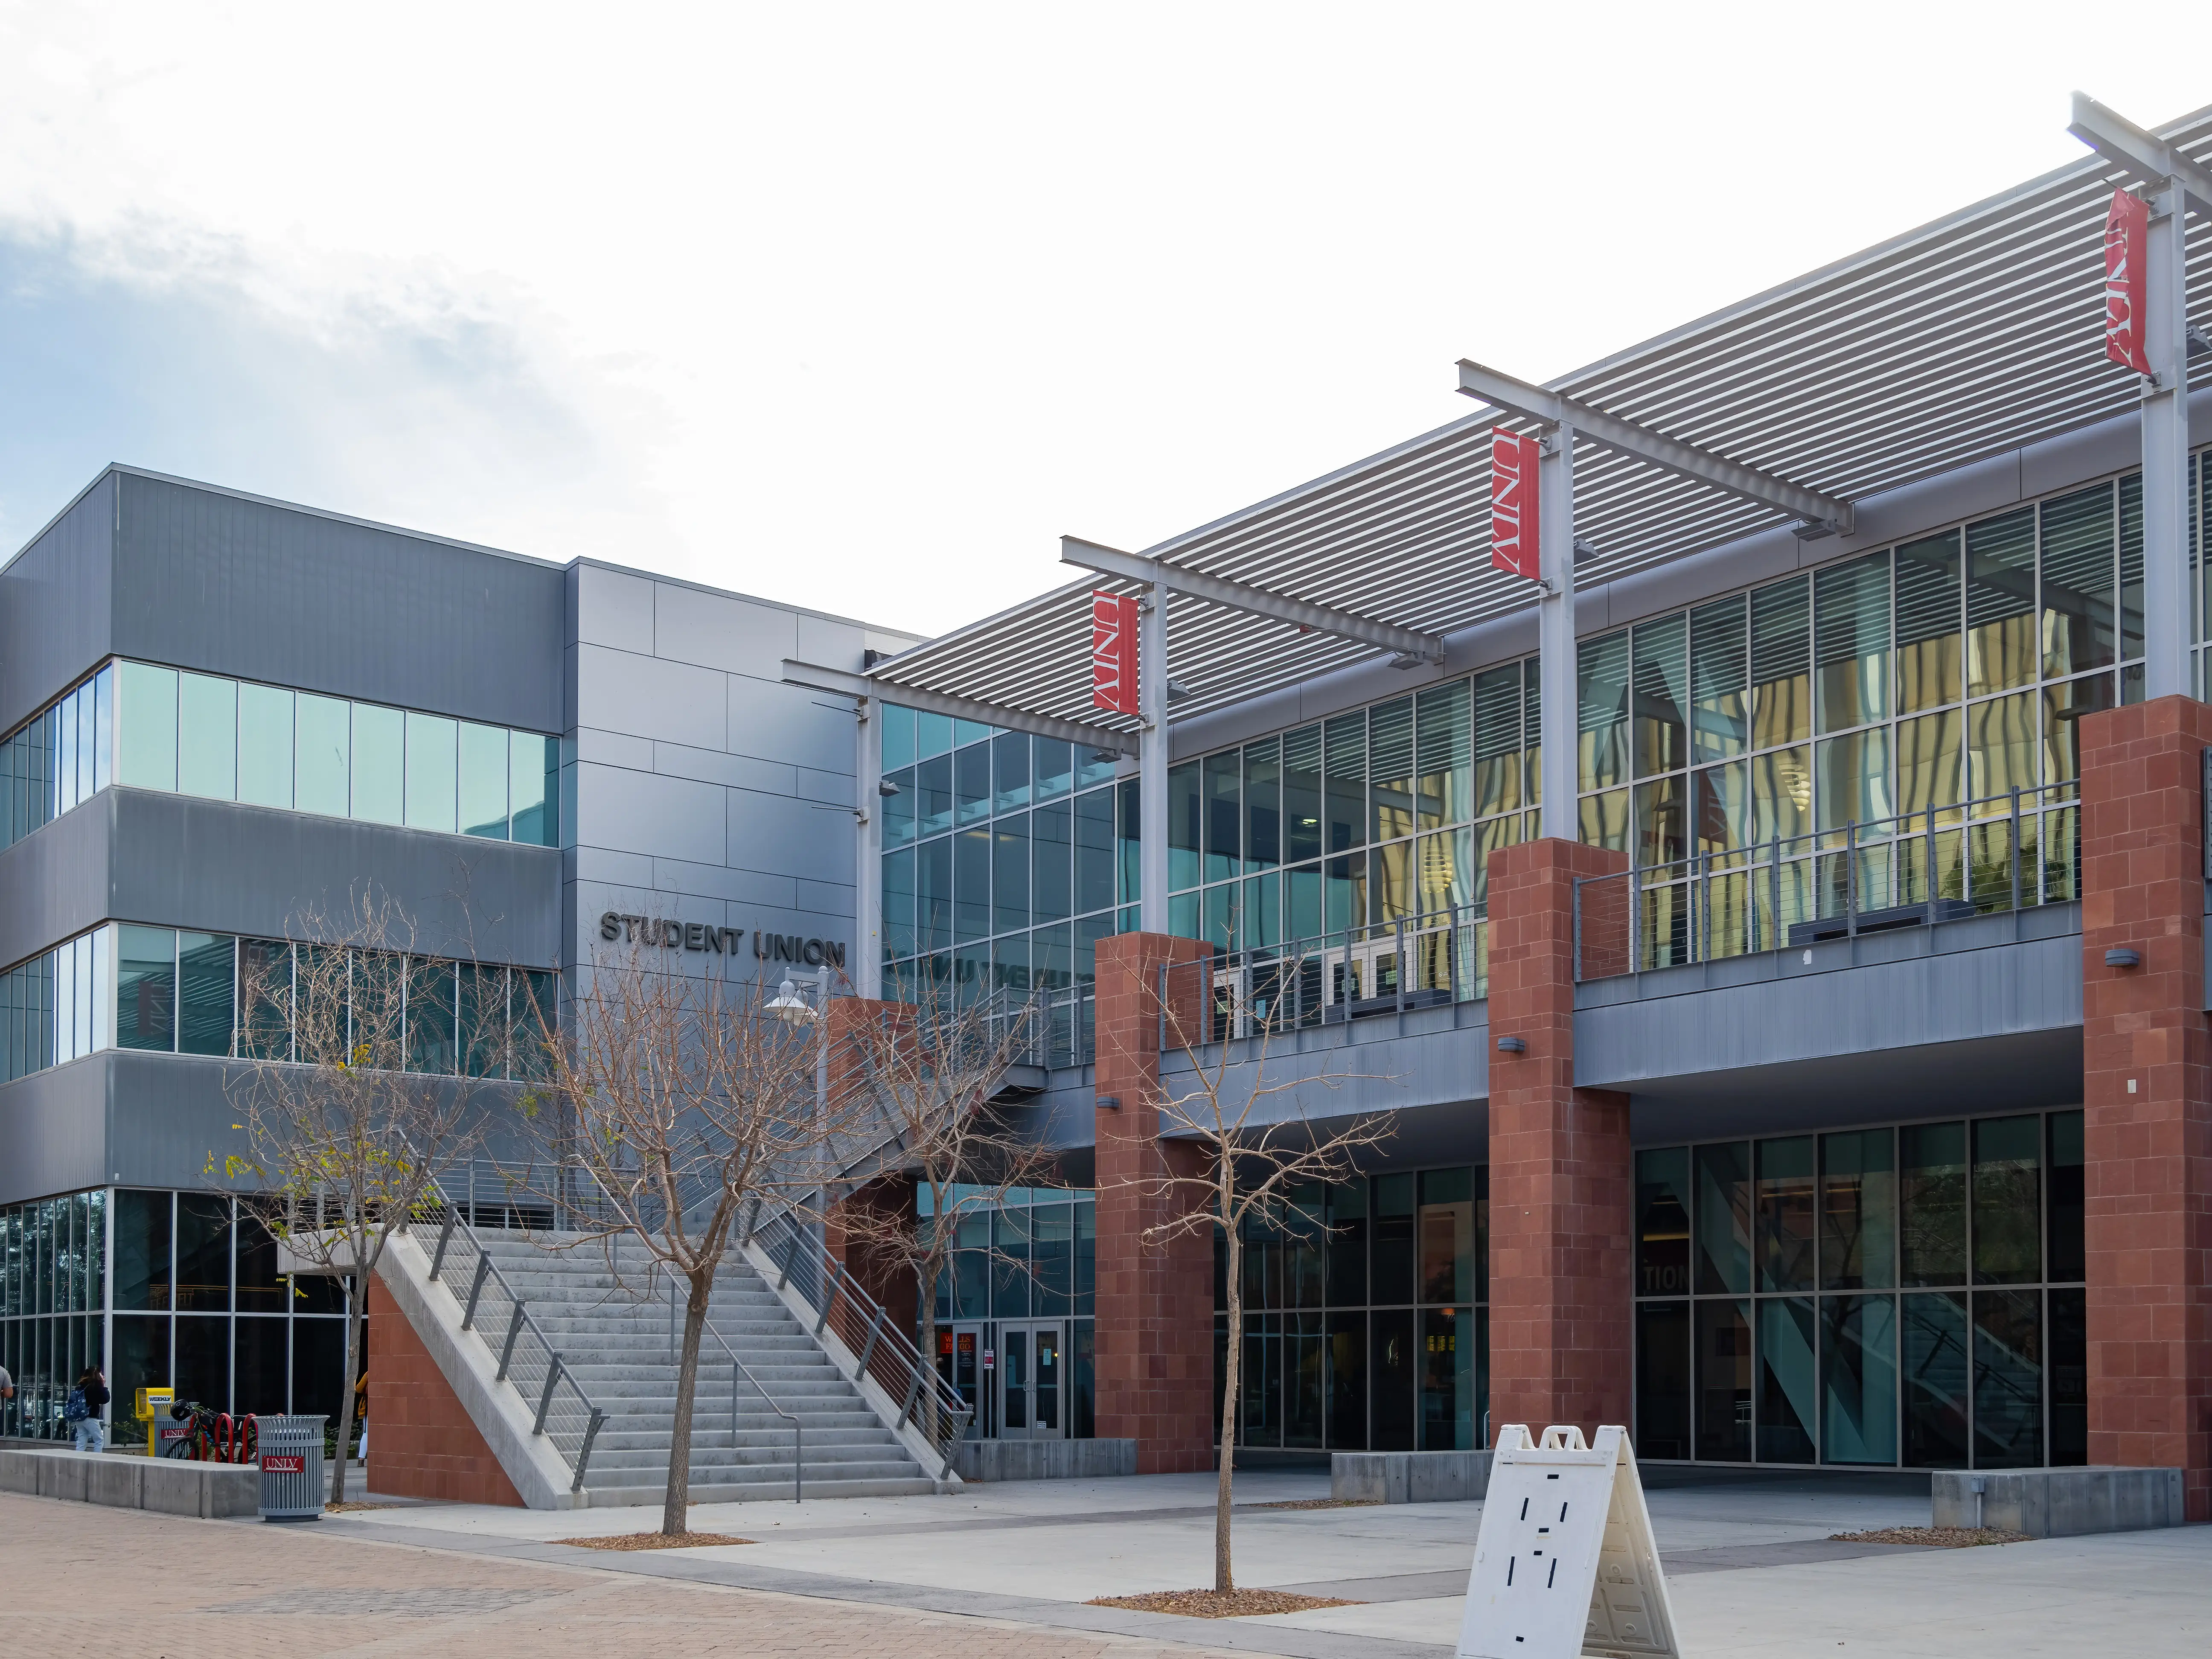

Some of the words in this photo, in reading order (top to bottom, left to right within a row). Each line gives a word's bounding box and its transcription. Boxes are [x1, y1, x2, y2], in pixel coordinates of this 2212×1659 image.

[1492, 434, 1520, 575] UNLV
[1093, 595, 1120, 712] UNLV
[601, 911, 744, 954] STUDENT
[754, 931, 846, 967] UNION
[267, 1458, 298, 1468] UNLV
